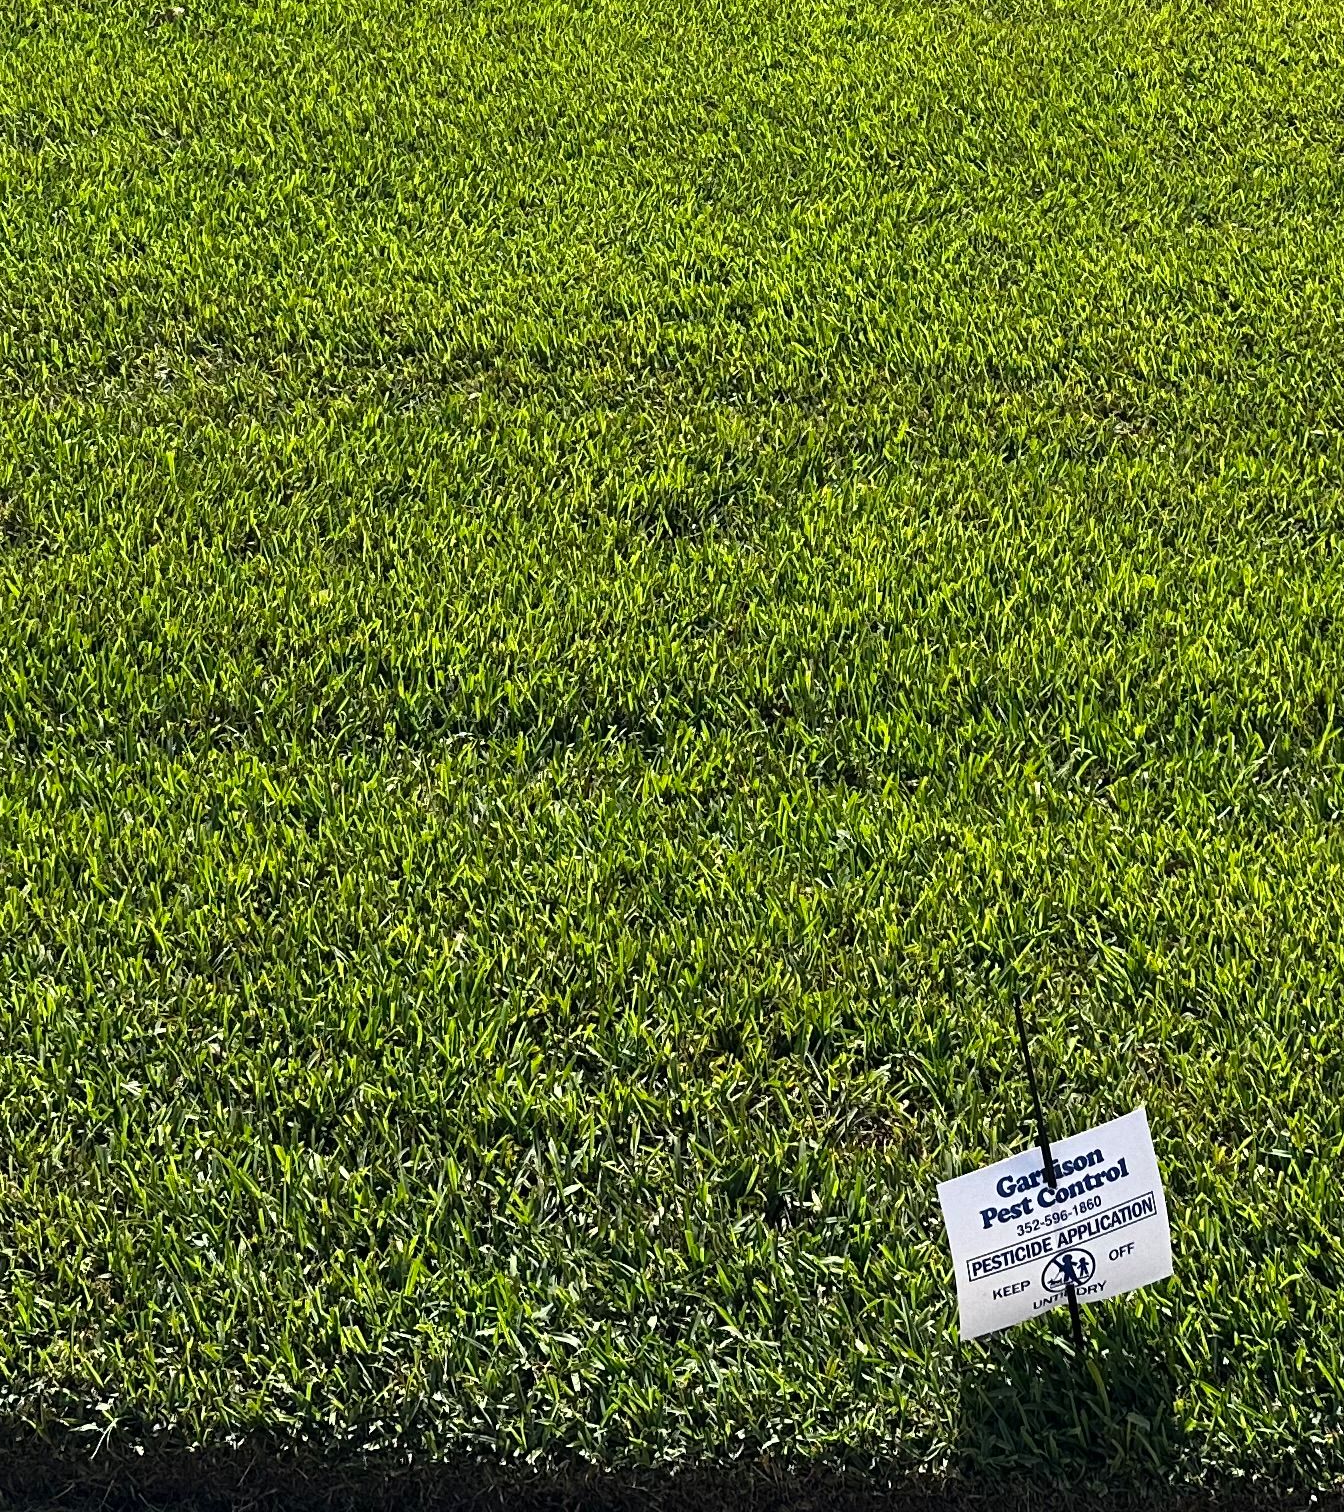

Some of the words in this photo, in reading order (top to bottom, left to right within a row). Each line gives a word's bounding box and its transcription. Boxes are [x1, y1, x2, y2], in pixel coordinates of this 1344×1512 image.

[980, 1197, 1033, 1229] Pest
[1037, 1157, 1129, 1208] Control
[1016, 1195, 1102, 1237] 352-596-1860
[972, 1237, 1053, 1277] PESTICIDE
[1057, 1197, 1154, 1248] APPLICATION
[992, 1280, 1031, 1300] KEEP
[1108, 1242, 1135, 1262] OFF
[1077, 1280, 1107, 1296] DRY
